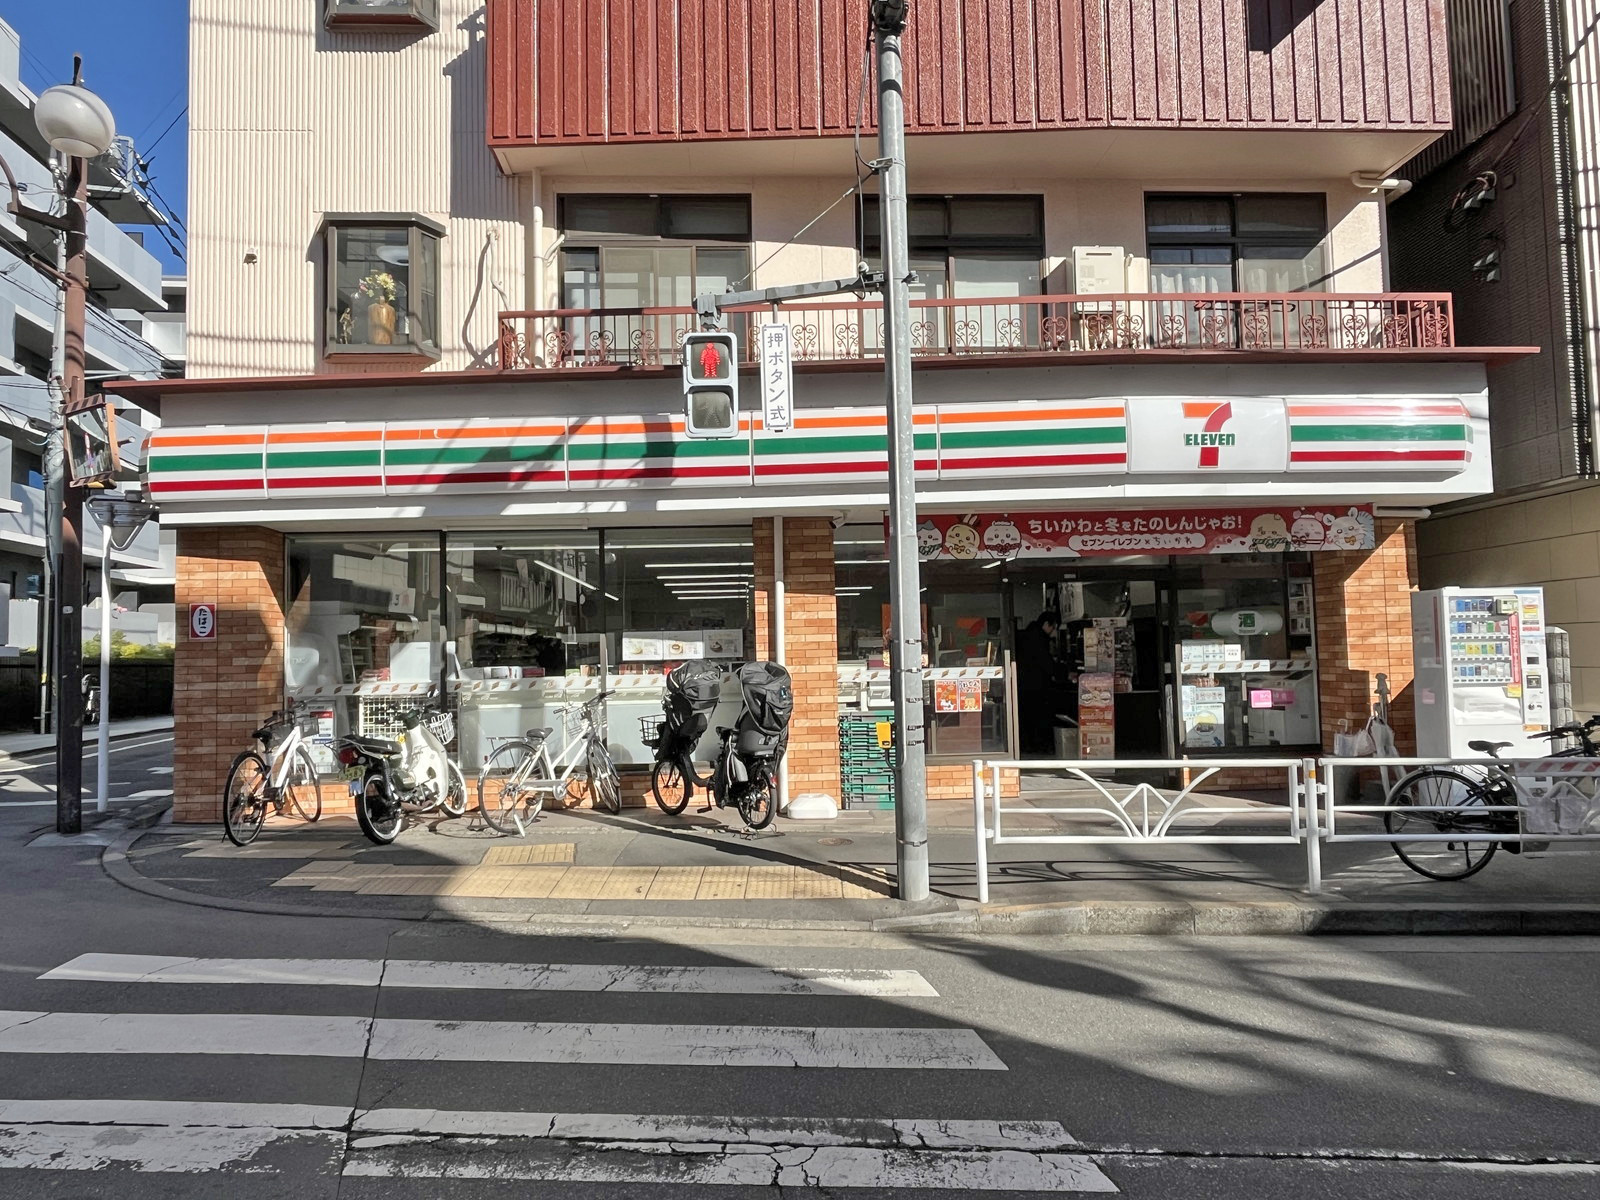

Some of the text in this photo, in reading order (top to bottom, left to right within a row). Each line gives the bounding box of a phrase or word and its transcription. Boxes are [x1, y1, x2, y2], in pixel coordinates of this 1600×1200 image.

[767, 332, 786, 421] 押ボタン式
[198, 608, 208, 634] たばこ
[1238, 612, 1256, 628] 酒
